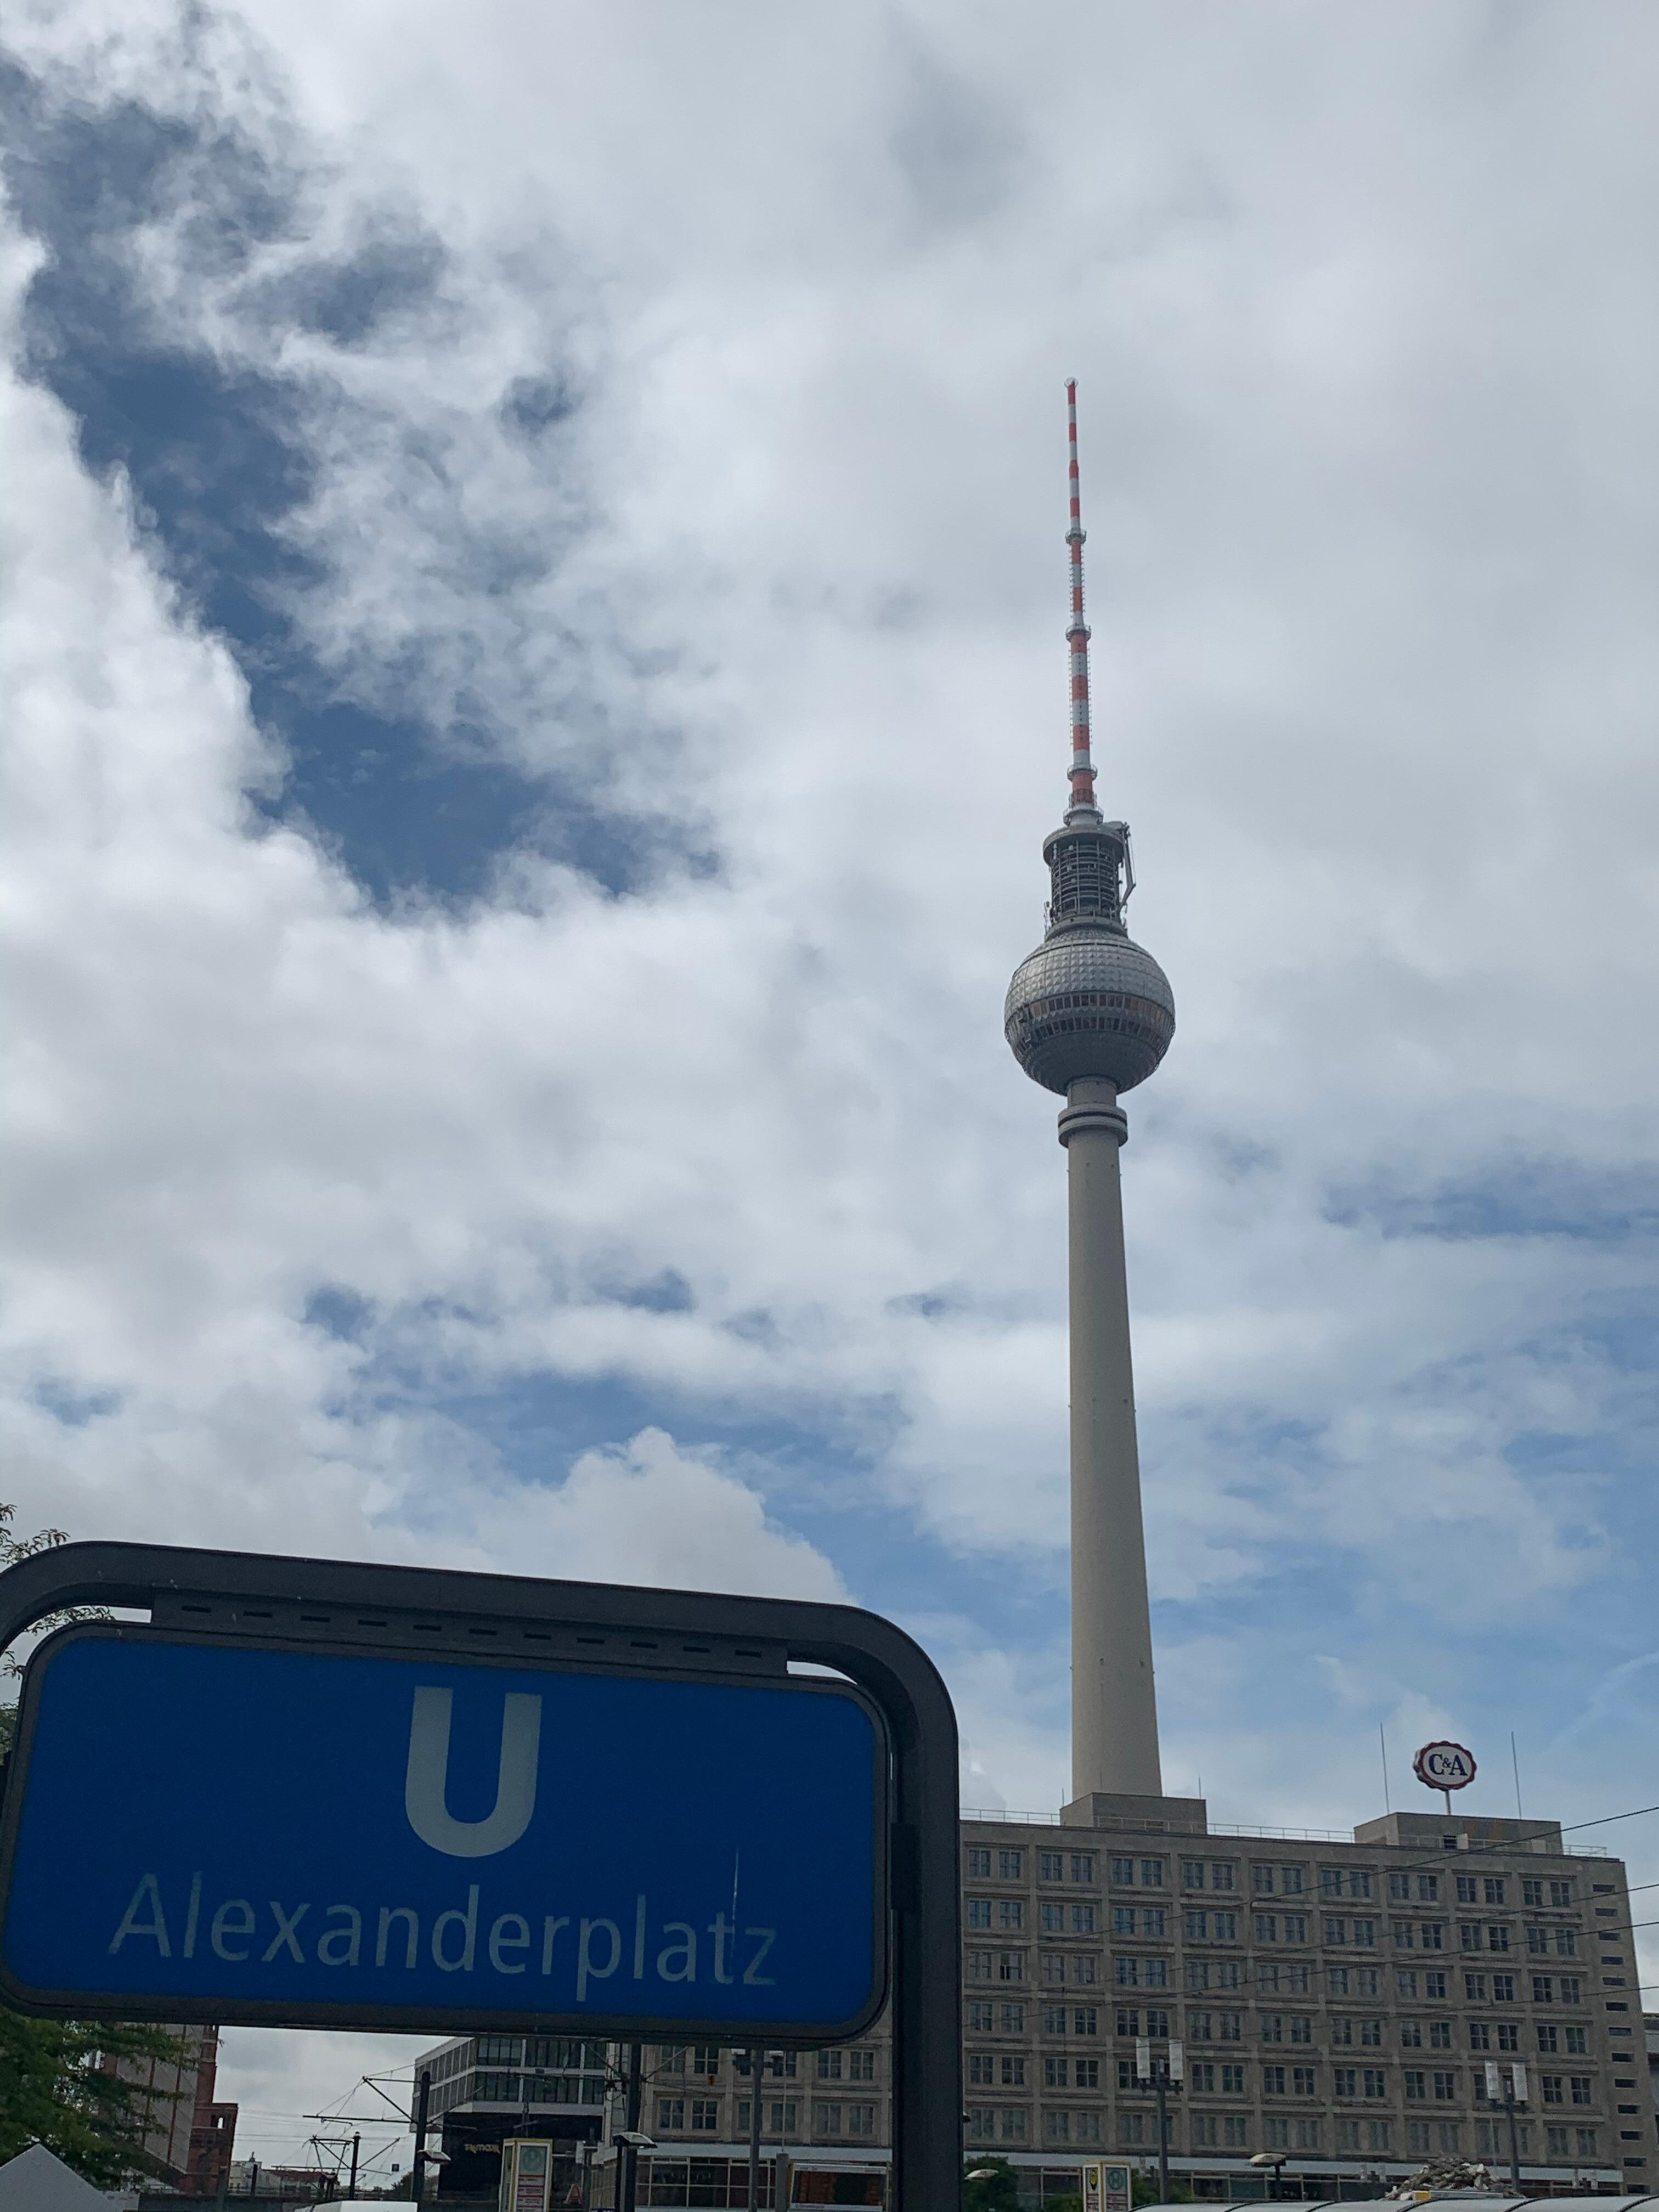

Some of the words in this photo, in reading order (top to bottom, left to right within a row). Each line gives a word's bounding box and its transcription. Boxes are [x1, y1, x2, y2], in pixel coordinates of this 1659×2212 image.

[404, 1685, 543, 1858] U
[1429, 1753, 1469, 1775] C&A
[108, 1872, 777, 2001] Alexanderplatz
